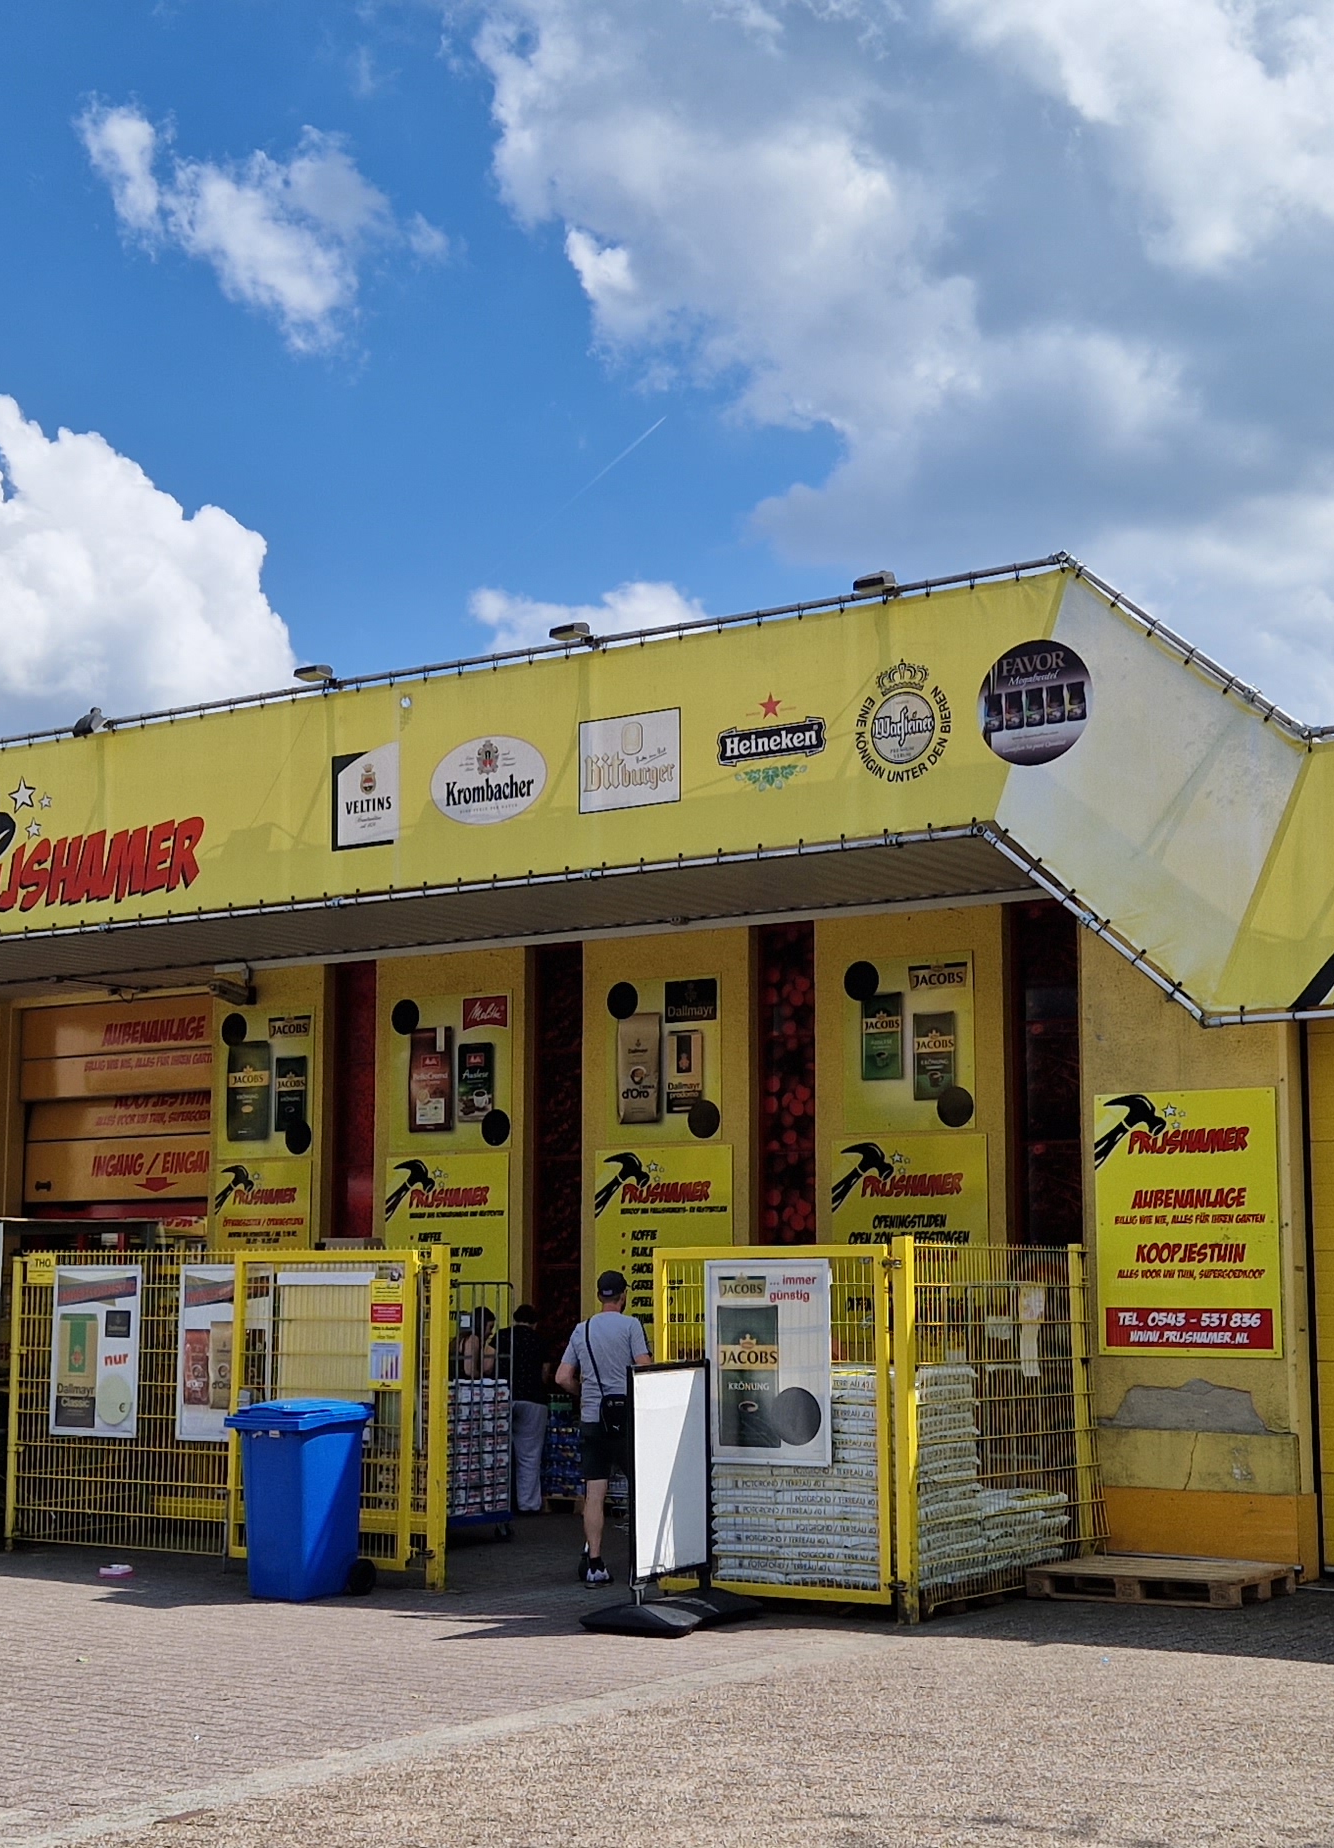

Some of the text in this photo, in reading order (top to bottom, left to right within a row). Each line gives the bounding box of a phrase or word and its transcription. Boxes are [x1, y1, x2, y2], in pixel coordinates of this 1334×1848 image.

[1001, 651, 1066, 676] FAVOR
[855, 685, 951, 783] EINE KÖNIGIN UNTER DEN BIEREN
[725, 730, 817, 757] Heineken
[583, 752, 674, 793] Bitburger
[445, 774, 535, 807] Krombacher
[345, 796, 392, 815] VELTINS
[913, 972, 964, 988] JACOBS
[467, 1001, 502, 1021] Melitta
[667, 1006, 714, 1018] Dallmayr
[271, 1023, 308, 1036] JACOBS
[865, 1020, 900, 1031] JACOBS
[916, 1040, 954, 1050] JACOBS
[232, 1074, 264, 1085] JACOBS
[462, 1069, 489, 1079] Auslese
[277, 1080, 305, 1089] JACOBS
[668, 1082, 700, 1091] Dallmayr
[622, 1088, 649, 1099] d'Oro
[669, 1090, 699, 1100] prodomo
[1128, 1127, 1249, 1155] PRIJSHAMER
[91, 1152, 144, 1177] INGANG
[861, 1173, 964, 1197] PRIJSHAMER
[233, 1187, 297, 1205] PRIJSHAMER
[409, 1186, 490, 1209] PRIJSHAMER
[621, 1181, 711, 1204] PRIJSHAMER
[872, 1214, 947, 1229] OPENINGSTIJDEN
[1114, 1215, 1138, 1225] BILLIG
[1139, 1215, 1152, 1224] WIE
[1171, 1214, 1193, 1224] ALLES
[1195, 1212, 1210, 1224] FÜR
[1211, 1214, 1234, 1224] IHREN
[1235, 1214, 1266, 1224] GARTEN
[418, 1232, 442, 1242] KAFFEE
[631, 1230, 658, 1241] KOFFIE
[848, 1231, 872, 1245] OPEN
[461, 1247, 483, 1258] PFAND
[1135, 1243, 1247, 1264] KOOPJESTUIN
[1117, 1269, 1265, 1280] ALLES VOOR UW TUIN, SUPERGOEDKOOP
[722, 1275, 817, 1296] JACOBS immer
[770, 1290, 810, 1302] günstig
[1118, 1312, 1144, 1326] TEL.
[1147, 1312, 1186, 1327] 0543
[1200, 1313, 1227, 1327] 531
[1229, 1313, 1261, 1328] 836
[1129, 1330, 1250, 1344] WWW.PRIJSHAMER.NL
[104, 1353, 128, 1367] nur
[720, 1350, 777, 1366] JACOBS
[57, 1382, 95, 1397] Dallmayr
[728, 1380, 769, 1391] KRÖNUNG
[60, 1397, 90, 1409] Classic
[119, 1403, 126, 1413] €
